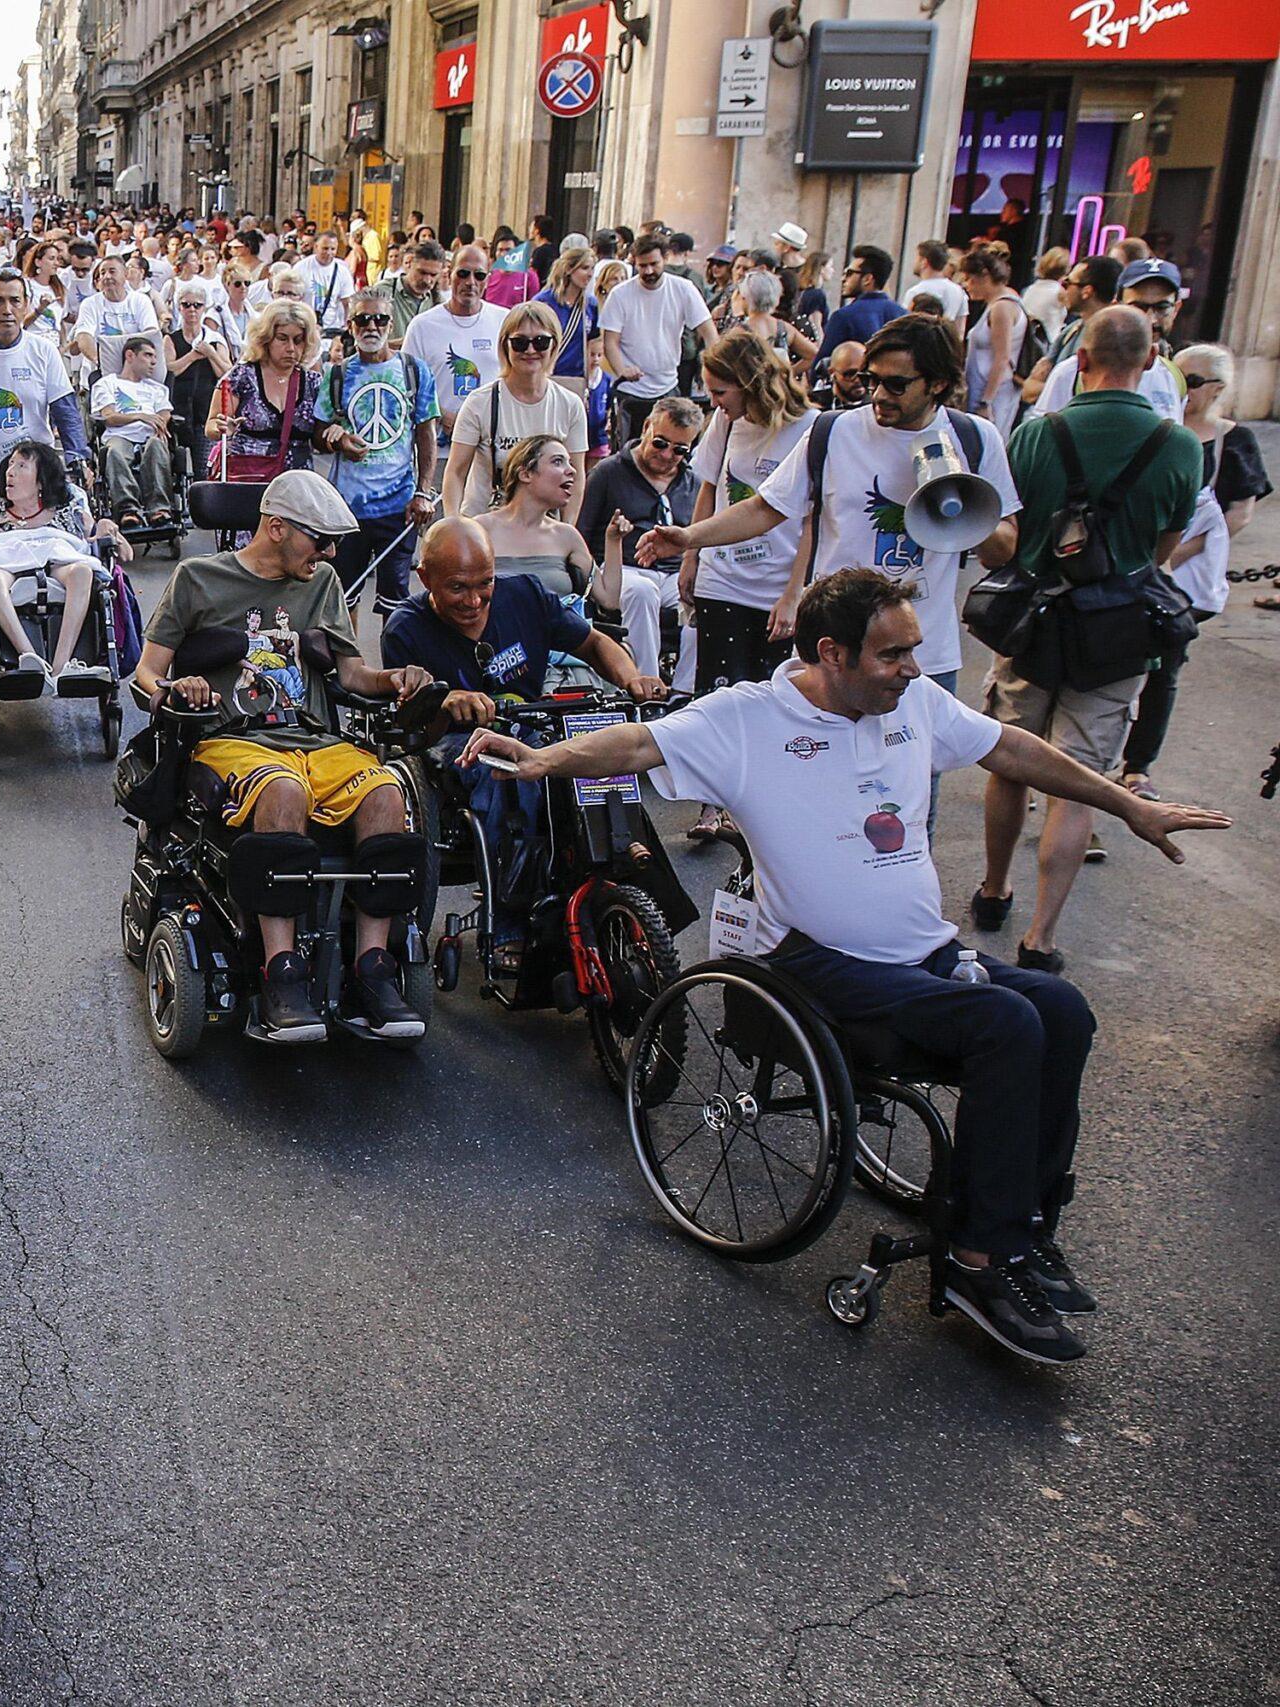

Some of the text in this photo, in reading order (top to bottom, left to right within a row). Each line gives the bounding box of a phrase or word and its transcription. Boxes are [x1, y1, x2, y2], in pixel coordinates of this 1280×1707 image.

[1069, 0, 1190, 48] Ray-Ban
[825, 78, 916, 90] LOUIS VUITTON
[488, 650, 525, 674] PRIDE
[345, 770, 367, 795] LOS
[723, 930, 742, 941] STAFF
